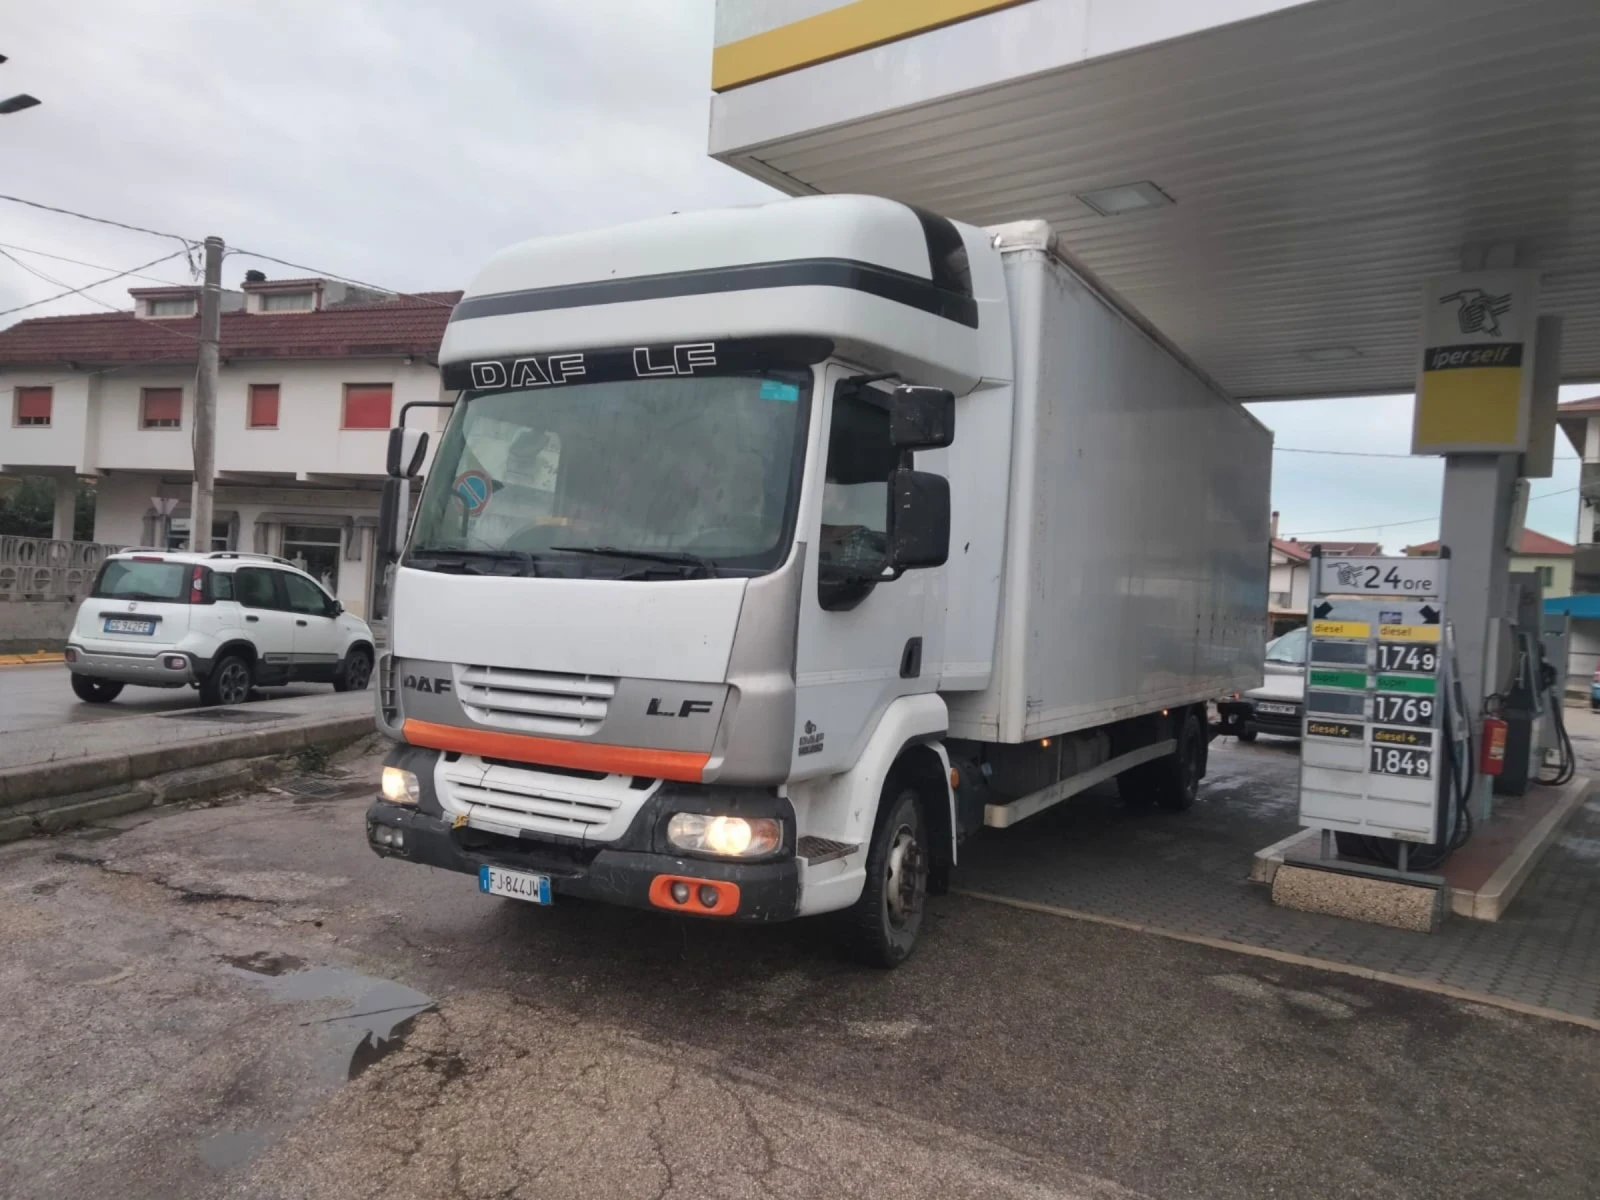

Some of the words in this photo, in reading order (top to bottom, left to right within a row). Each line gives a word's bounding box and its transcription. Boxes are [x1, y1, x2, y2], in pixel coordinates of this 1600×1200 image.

[470, 353, 587, 389] DAF
[633, 342, 717, 377] LF
[1431, 344, 1513, 369] iperself
[1364, 565, 1401, 589] 24
[1403, 579, 1433, 591] ore
[1314, 624, 1344, 633] diesel
[1380, 628, 1412, 637] diesel
[1379, 645, 1435, 671] 1,749
[1311, 672, 1341, 683] super
[1378, 676, 1408, 687] super
[402, 675, 452, 694] DAF
[646, 698, 712, 718] LF
[1375, 697, 1433, 722] 1,769
[1309, 724, 1338, 735] diesel
[1375, 731, 1405, 742] diesel
[1373, 748, 1429, 775] 1,849
